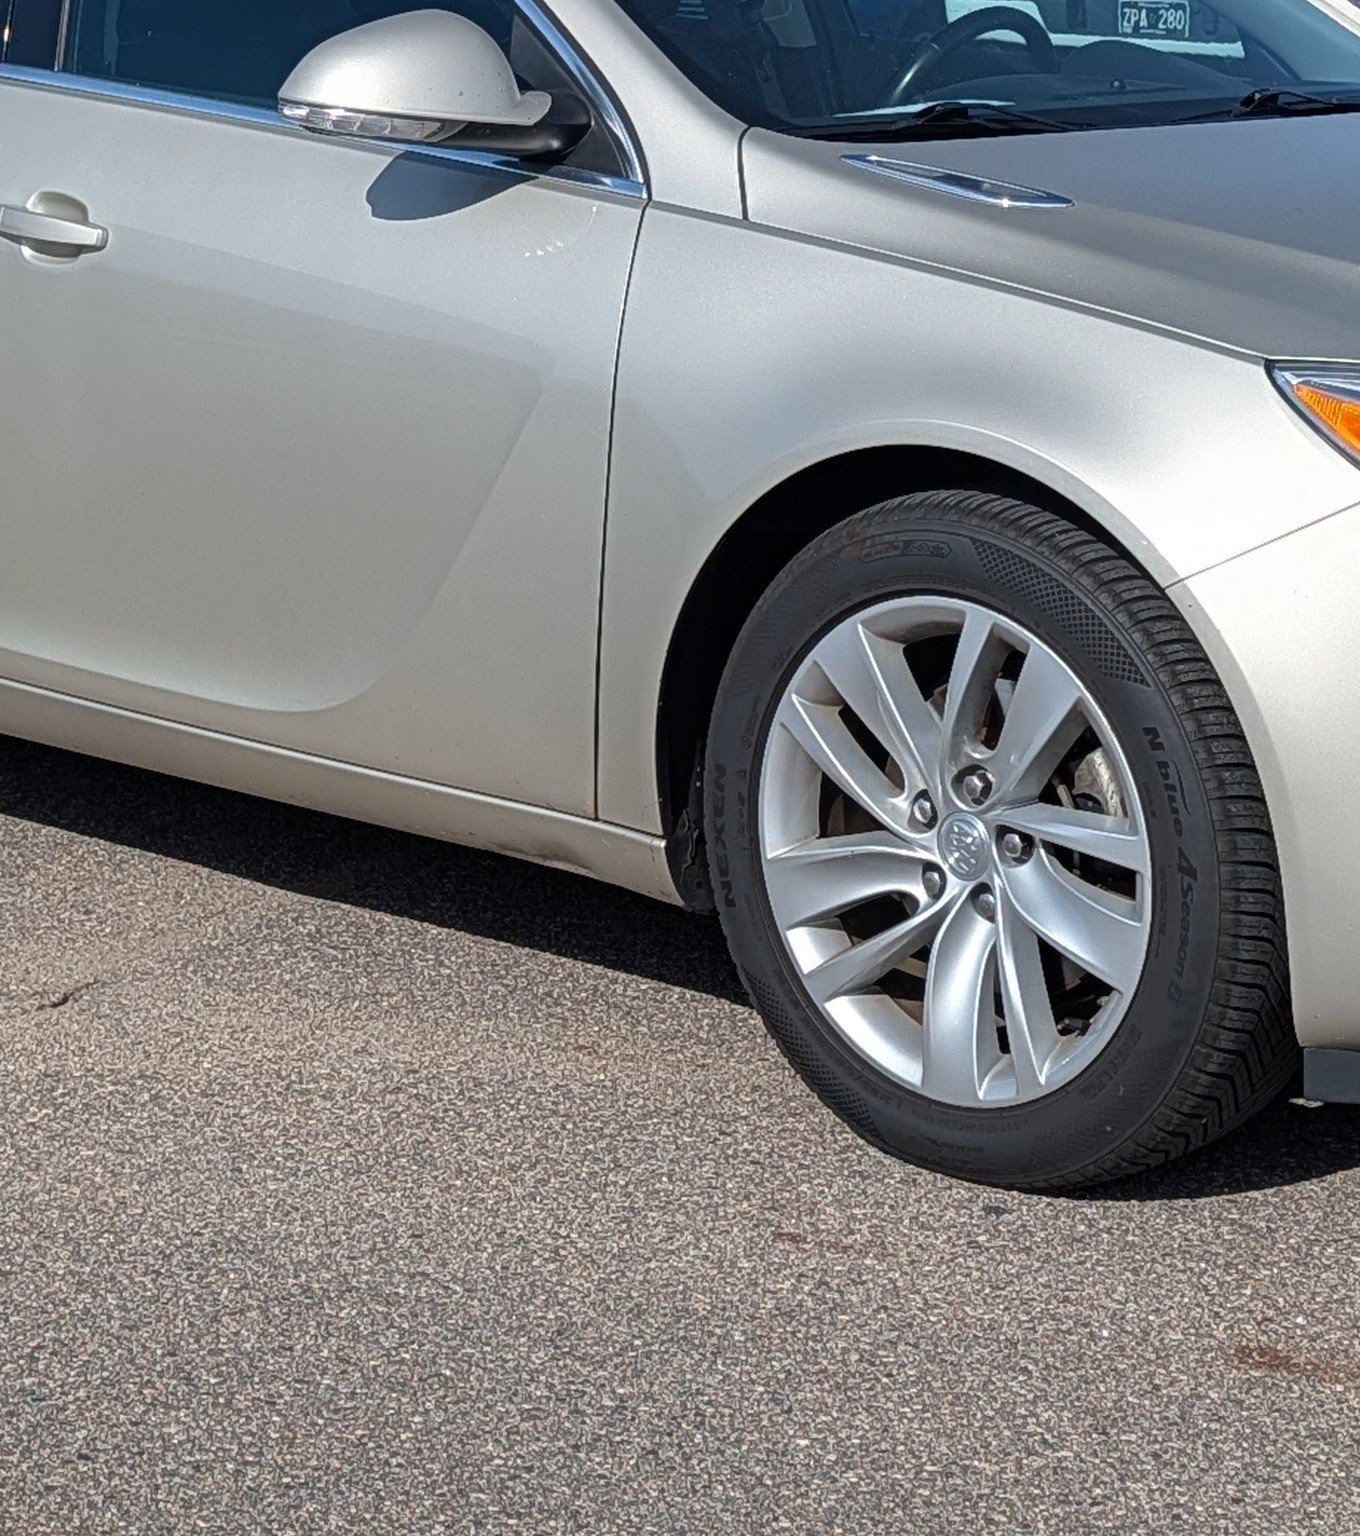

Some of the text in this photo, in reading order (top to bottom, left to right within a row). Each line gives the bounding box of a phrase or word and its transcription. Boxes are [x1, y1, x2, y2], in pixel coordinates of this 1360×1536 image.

[1121, 7, 1185, 30] ZPA 280
[714, 762, 736, 908] NEXEN
